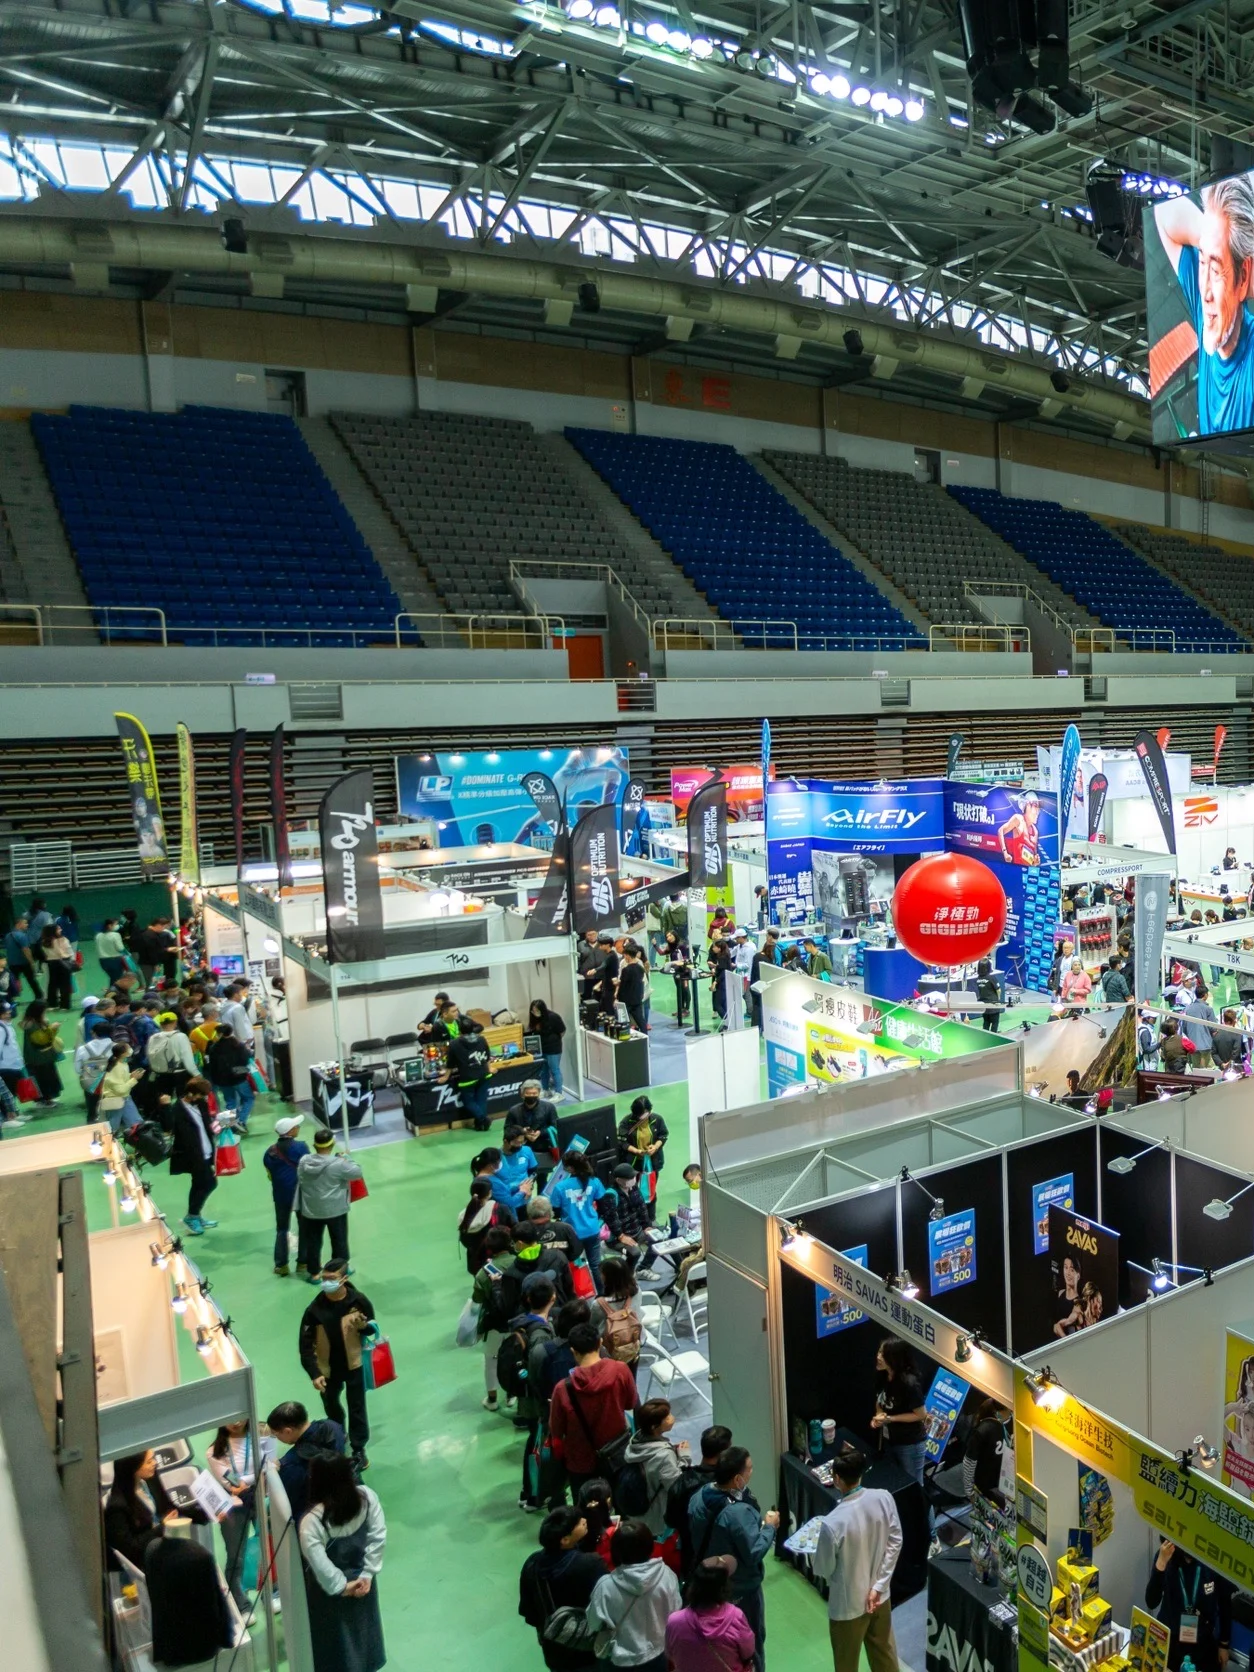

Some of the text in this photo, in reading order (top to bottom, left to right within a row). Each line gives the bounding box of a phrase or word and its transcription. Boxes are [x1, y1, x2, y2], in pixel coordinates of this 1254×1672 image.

[702, 376, 731, 409] E
[421, 777, 452, 792] LP
[710, 805, 718, 842] NUTRITION
[821, 808, 927, 829] AirFly
[589, 839, 599, 877] OPTIMUM
[597, 832, 606, 877] NUTRITION
[1097, 864, 1144, 876] COMPRESSPORT
[934, 906, 980, 921] 淨極勁
[1226, 953, 1241, 965] T8K
[953, 1268, 971, 1283] 500
[833, 1263, 937, 1346] 明治 SAVAS 運動蛋白
[842, 1308, 863, 1324] 500
[1079, 1434, 1114, 1460] Ocean Biotech
[1138, 1453, 1199, 1511] 鹽續力
[1026, 1577, 1045, 1599] 自己
